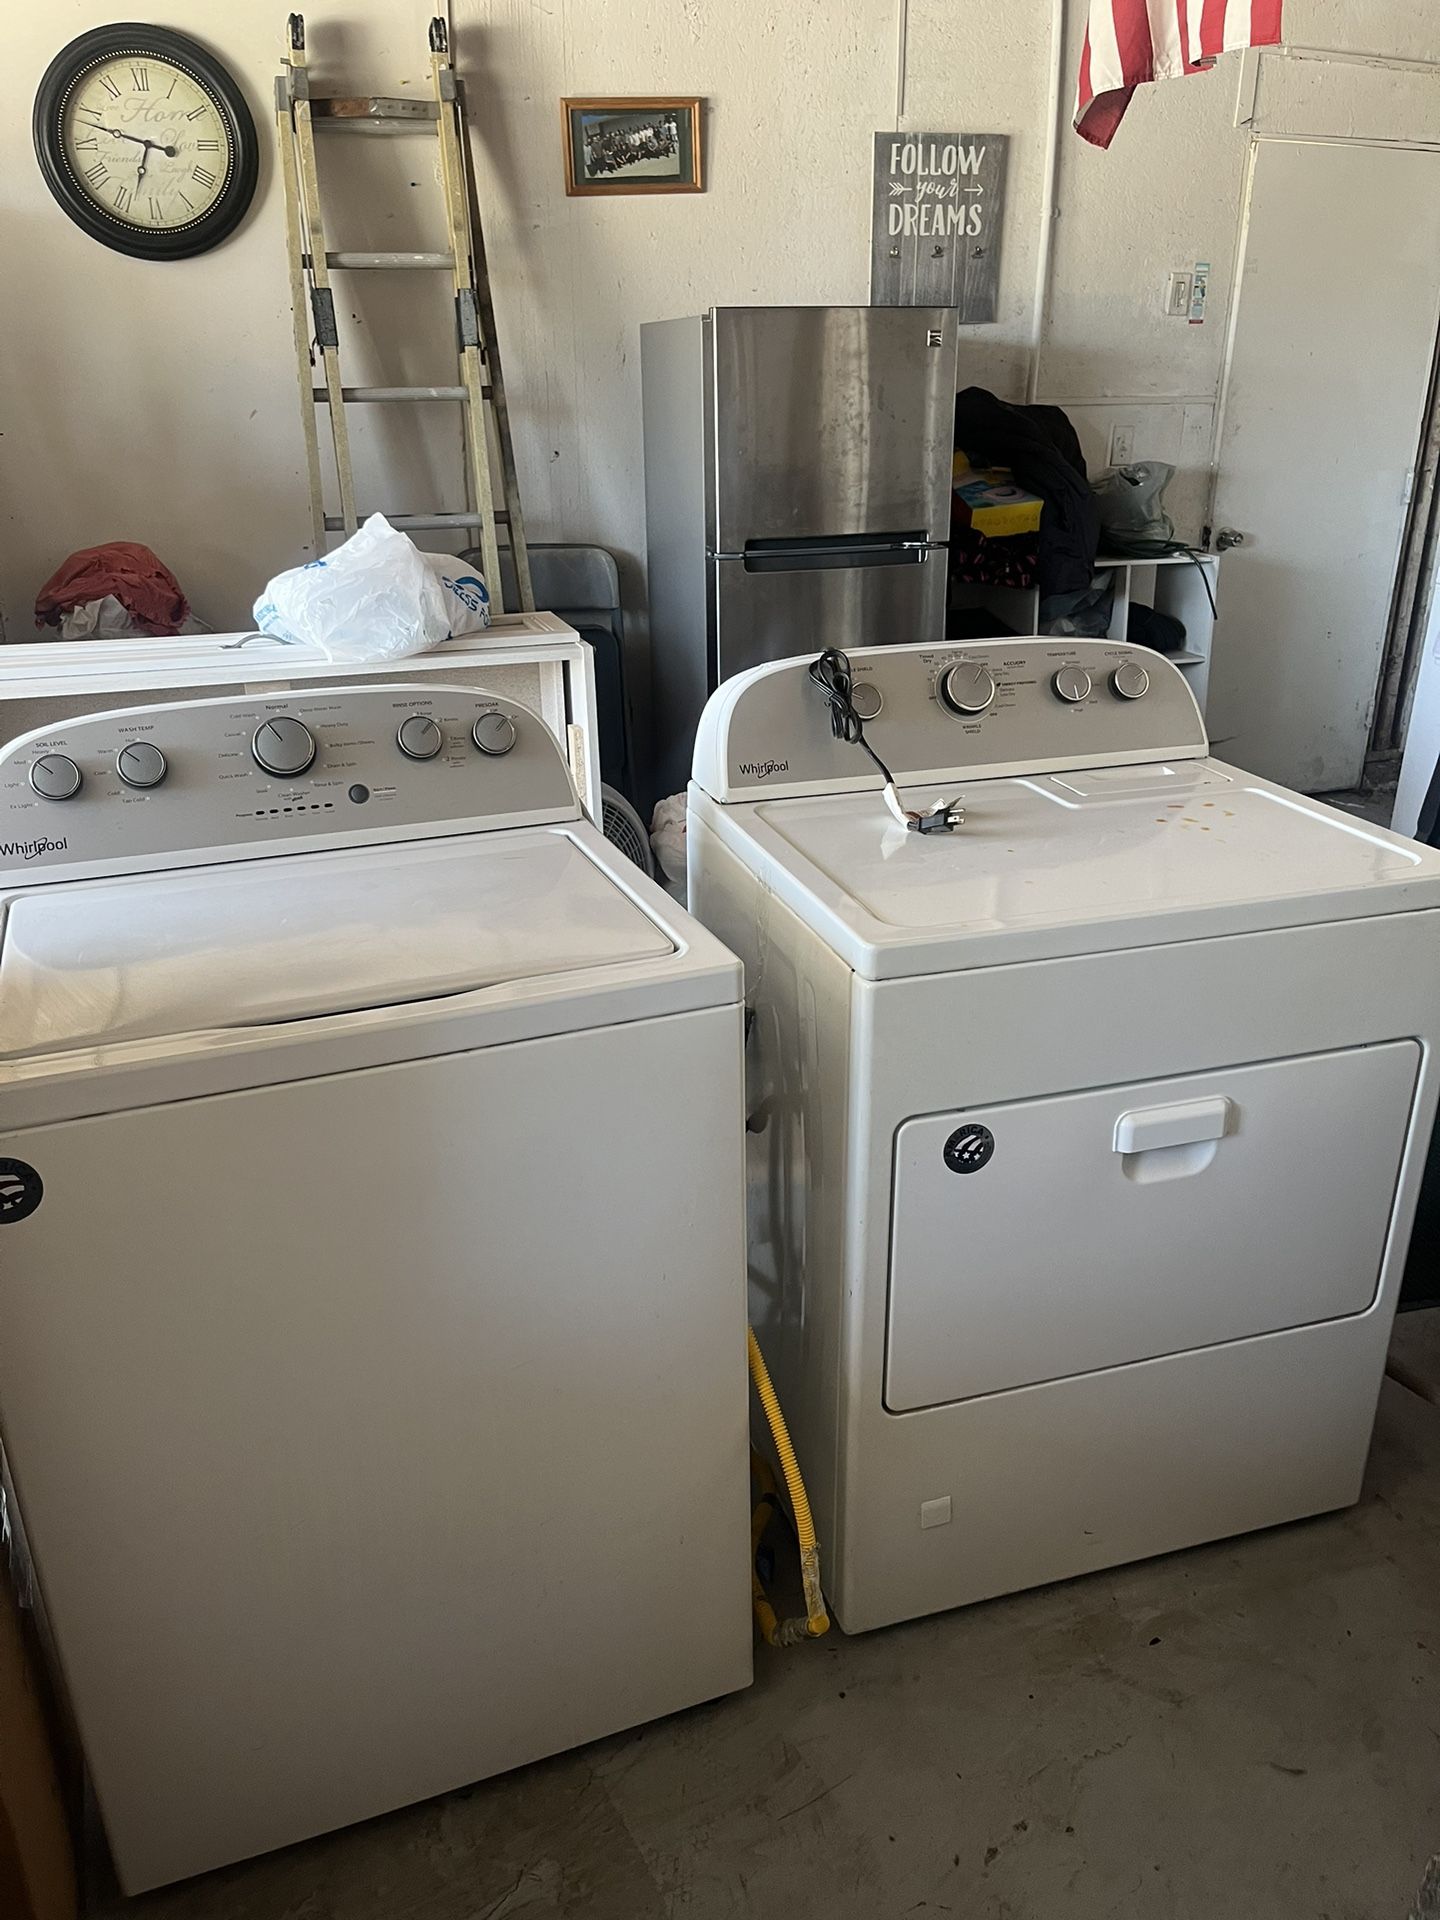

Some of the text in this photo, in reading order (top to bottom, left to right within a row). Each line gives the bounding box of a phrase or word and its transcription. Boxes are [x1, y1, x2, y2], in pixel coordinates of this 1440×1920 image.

[99, 75, 121, 101] XI
[130, 68, 150, 91] XII
[197, 140, 219, 151] III
[890, 143, 986, 175] FOLLOW
[915, 178, 959, 202] your
[889, 203, 982, 236] DREAMS
[739, 760, 789, 779] Whirlpool
[0, 837, 68, 860] Whirlpool
